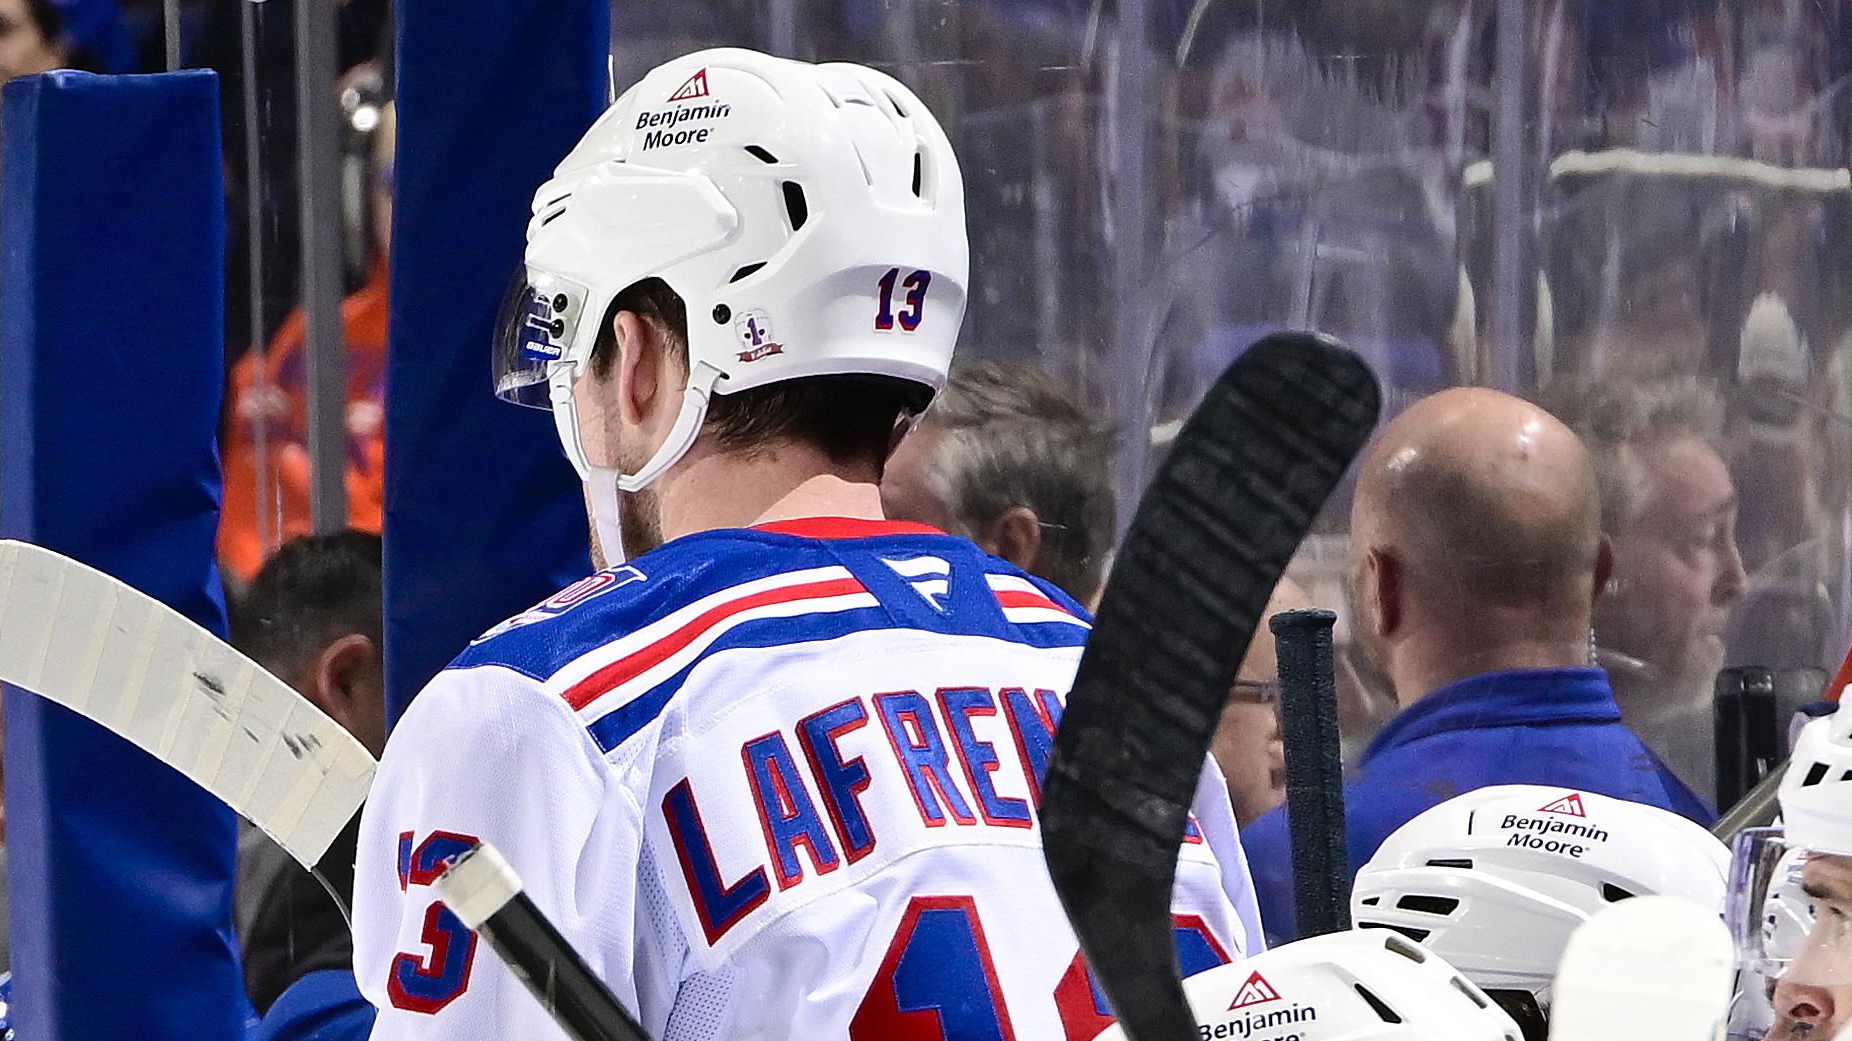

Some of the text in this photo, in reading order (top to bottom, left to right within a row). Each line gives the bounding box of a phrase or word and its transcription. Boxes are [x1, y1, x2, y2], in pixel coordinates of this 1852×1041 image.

[635, 99, 731, 130] Benjamin
[642, 129, 710, 152] Moore
[875, 268, 932, 332] 13
[1500, 814, 1609, 843] Benjamin
[1506, 833, 1584, 858] Moore
[386, 829, 481, 1016] 3
